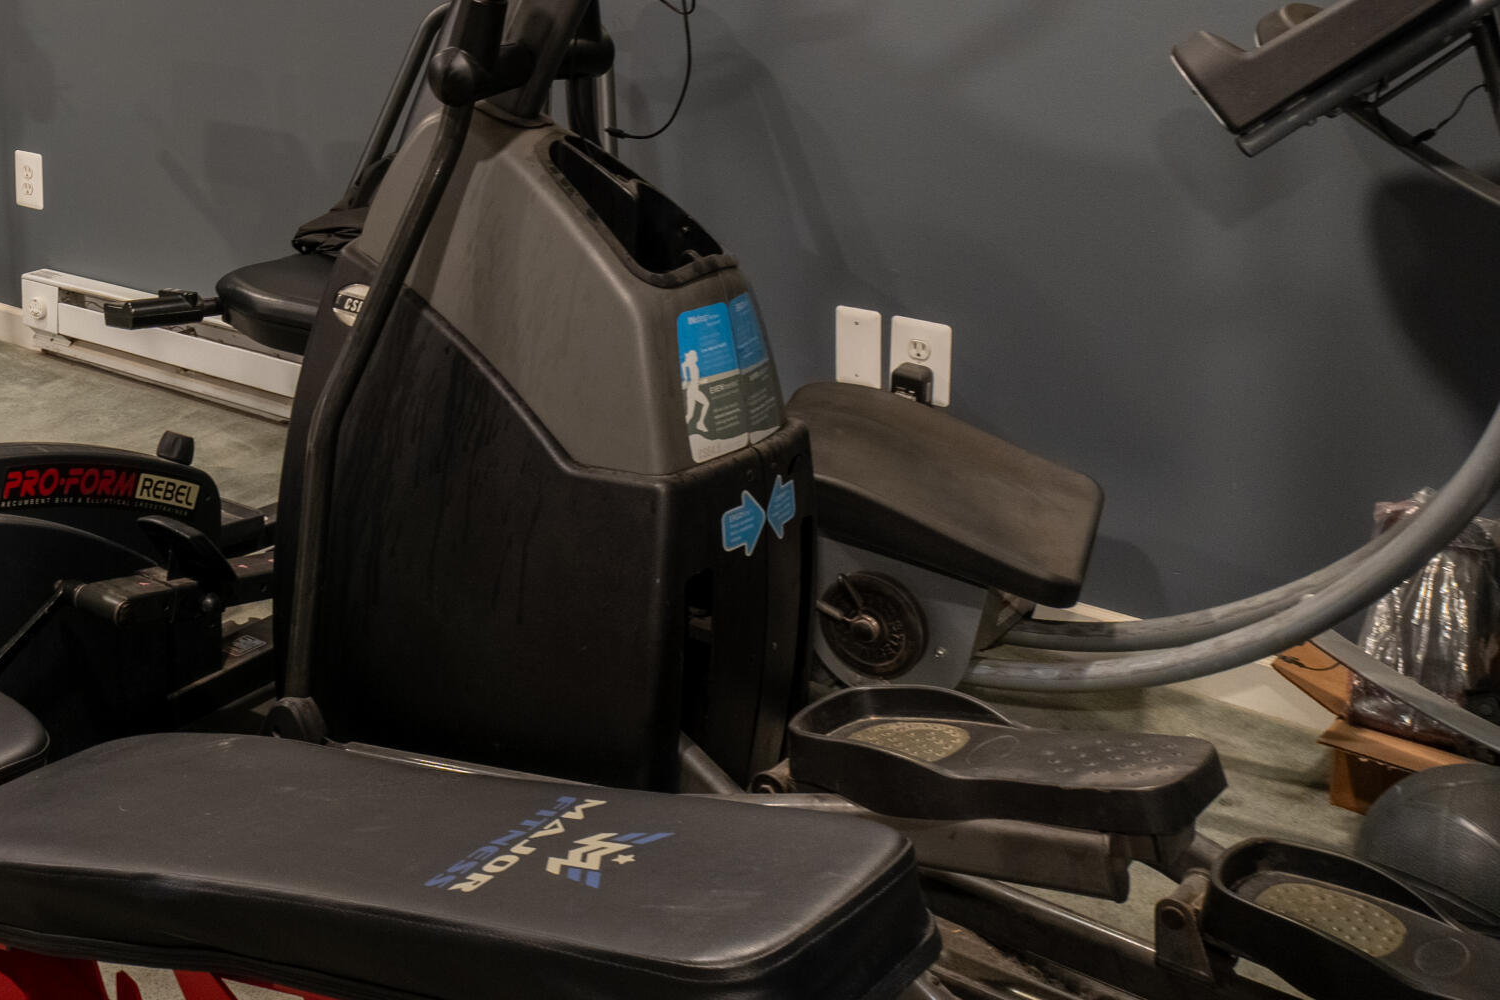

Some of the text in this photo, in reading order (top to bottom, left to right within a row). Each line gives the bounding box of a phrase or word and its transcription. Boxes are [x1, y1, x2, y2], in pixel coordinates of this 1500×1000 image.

[139, 477, 193, 507] REBEL
[424, 796, 577, 889] FITNESS
[447, 798, 607, 893] MAJOR
